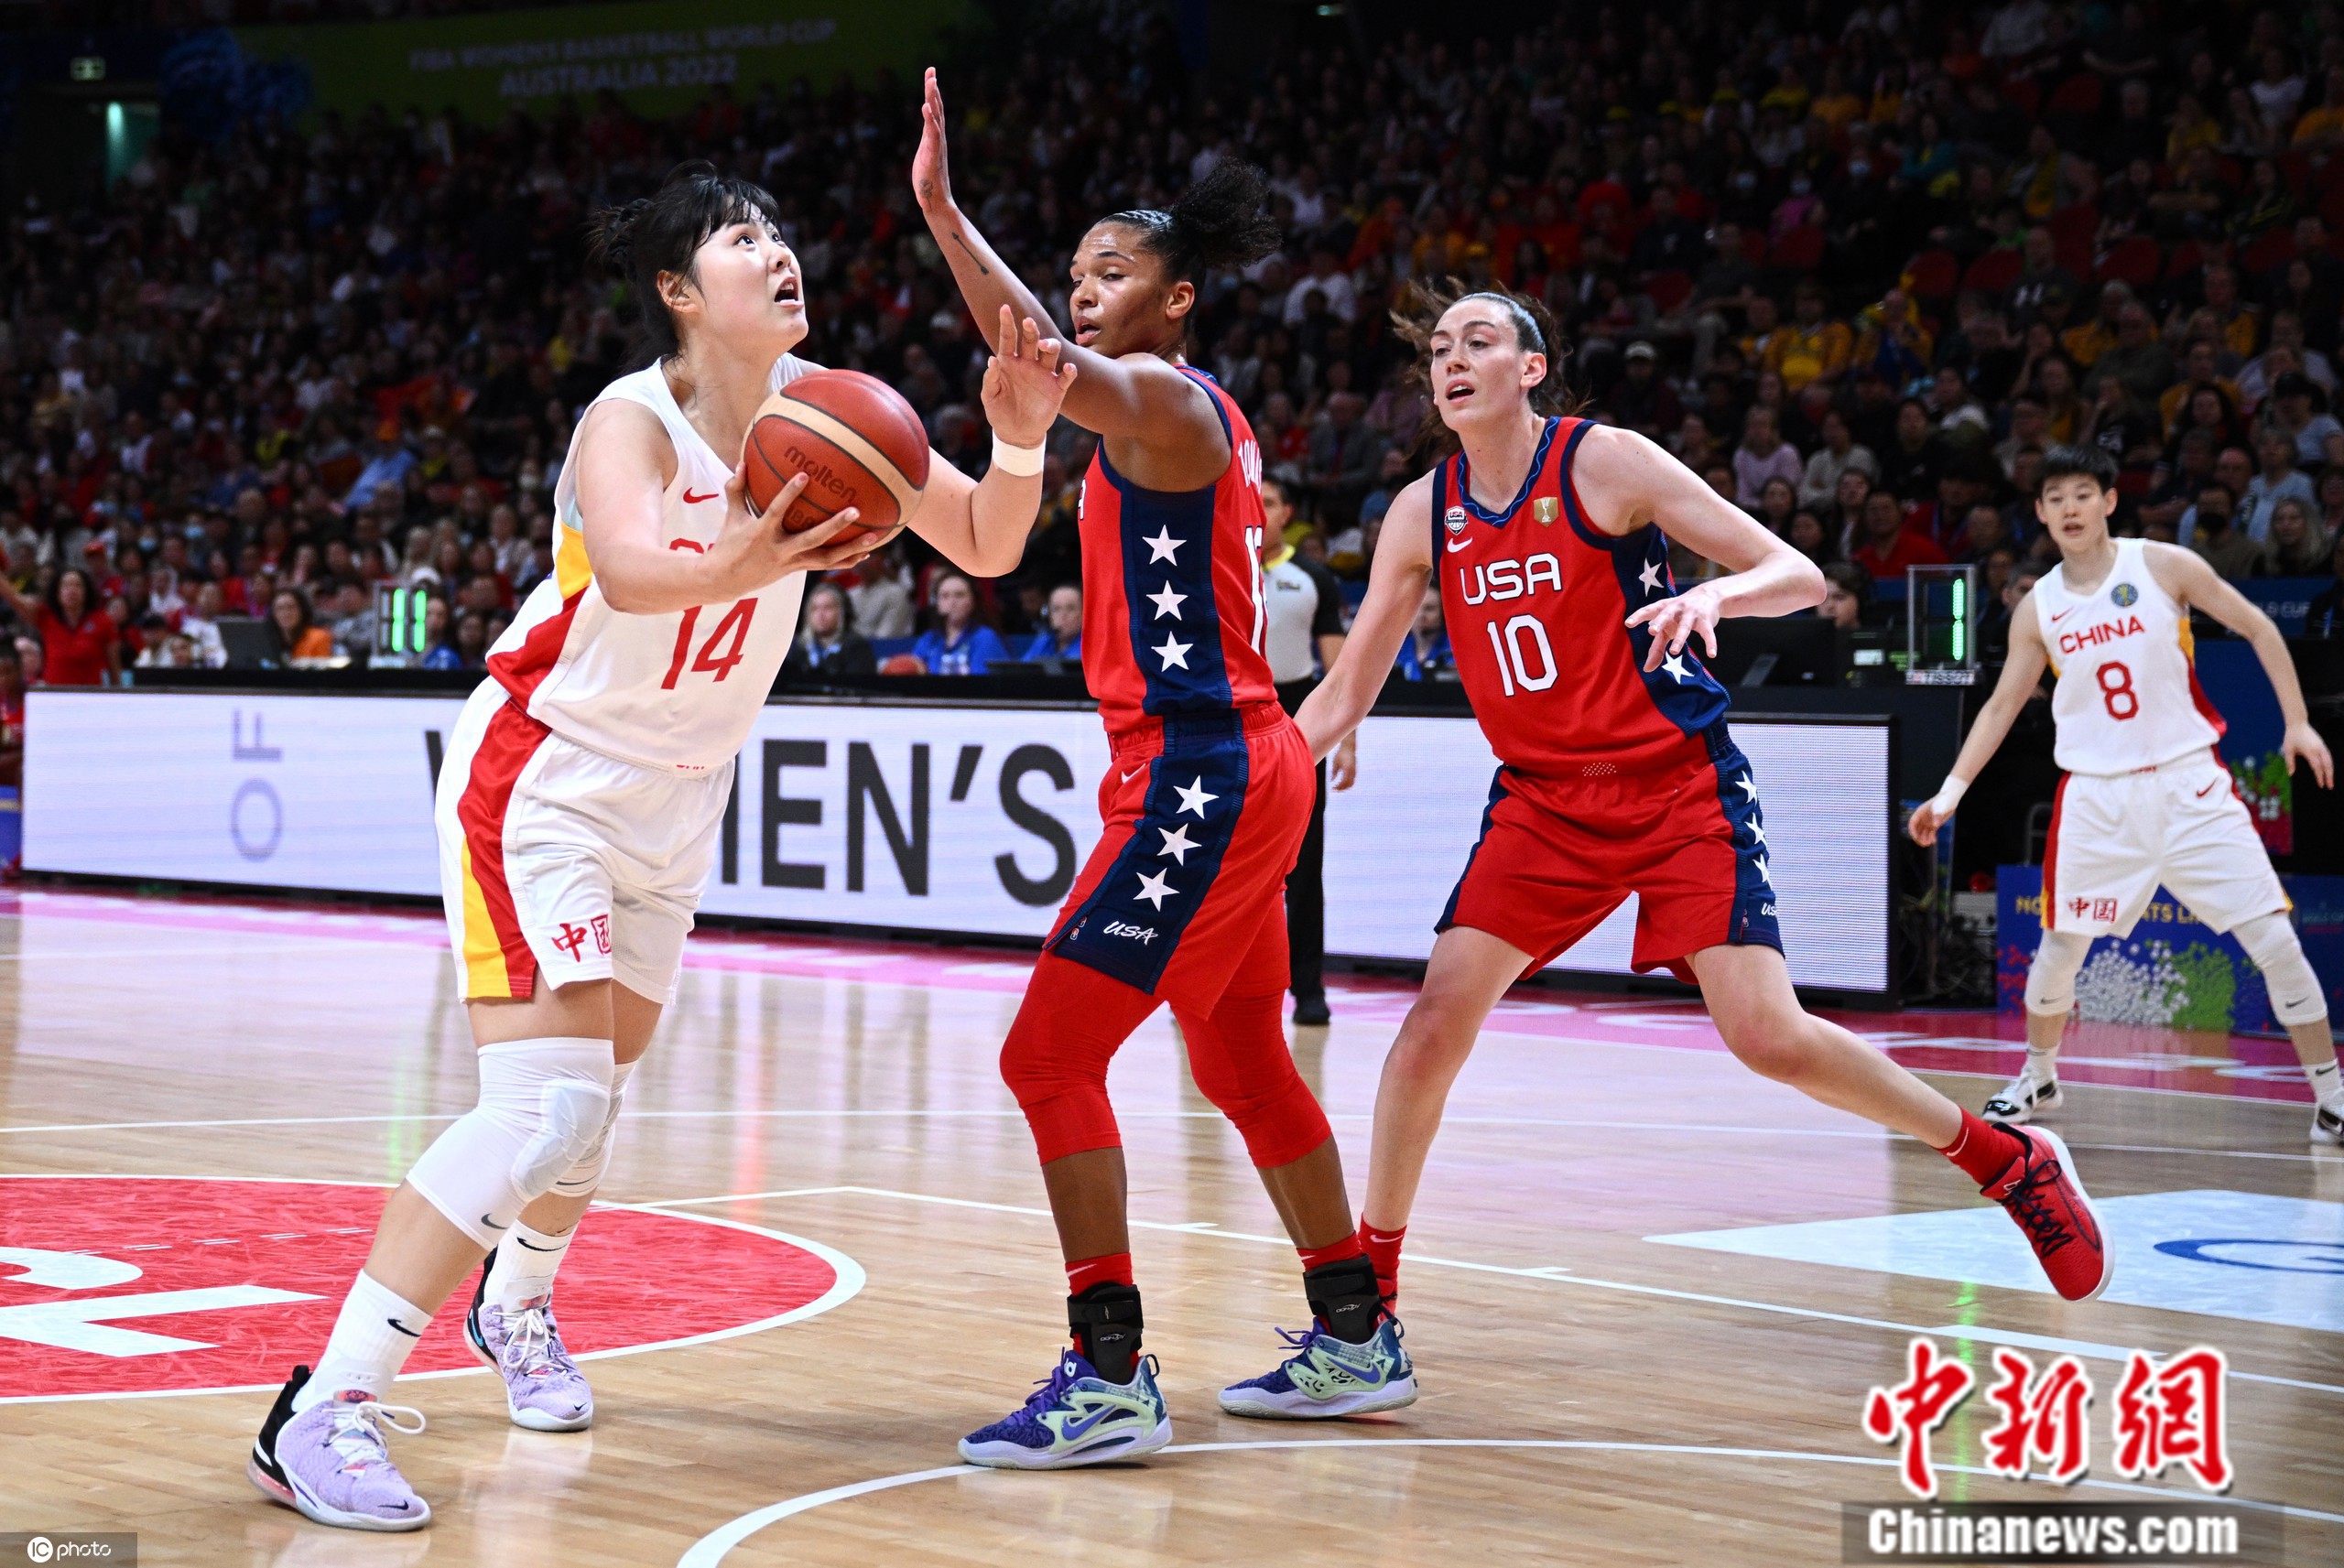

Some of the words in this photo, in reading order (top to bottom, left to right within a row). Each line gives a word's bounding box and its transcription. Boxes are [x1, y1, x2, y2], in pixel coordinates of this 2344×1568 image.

[462, 43, 558, 66] WOMEN'S
[563, 32, 700, 59] BASKETBALL
[704, 24, 788, 49] WORLD
[789, 18, 837, 44] CUP
[499, 60, 658, 97] AUSTRALIA
[665, 54, 737, 87] 2022
[784, 445, 857, 503] molten
[1460, 553, 1562, 606] USA
[661, 597, 758, 690] 14
[1486, 613, 1558, 697] 10
[2059, 615, 2146, 654] CHINA
[2096, 660, 2140, 721] 8
[1103, 920, 1158, 946] USA
[2069, 897, 2118, 924] 中国
[551, 914, 612, 963] 中国
